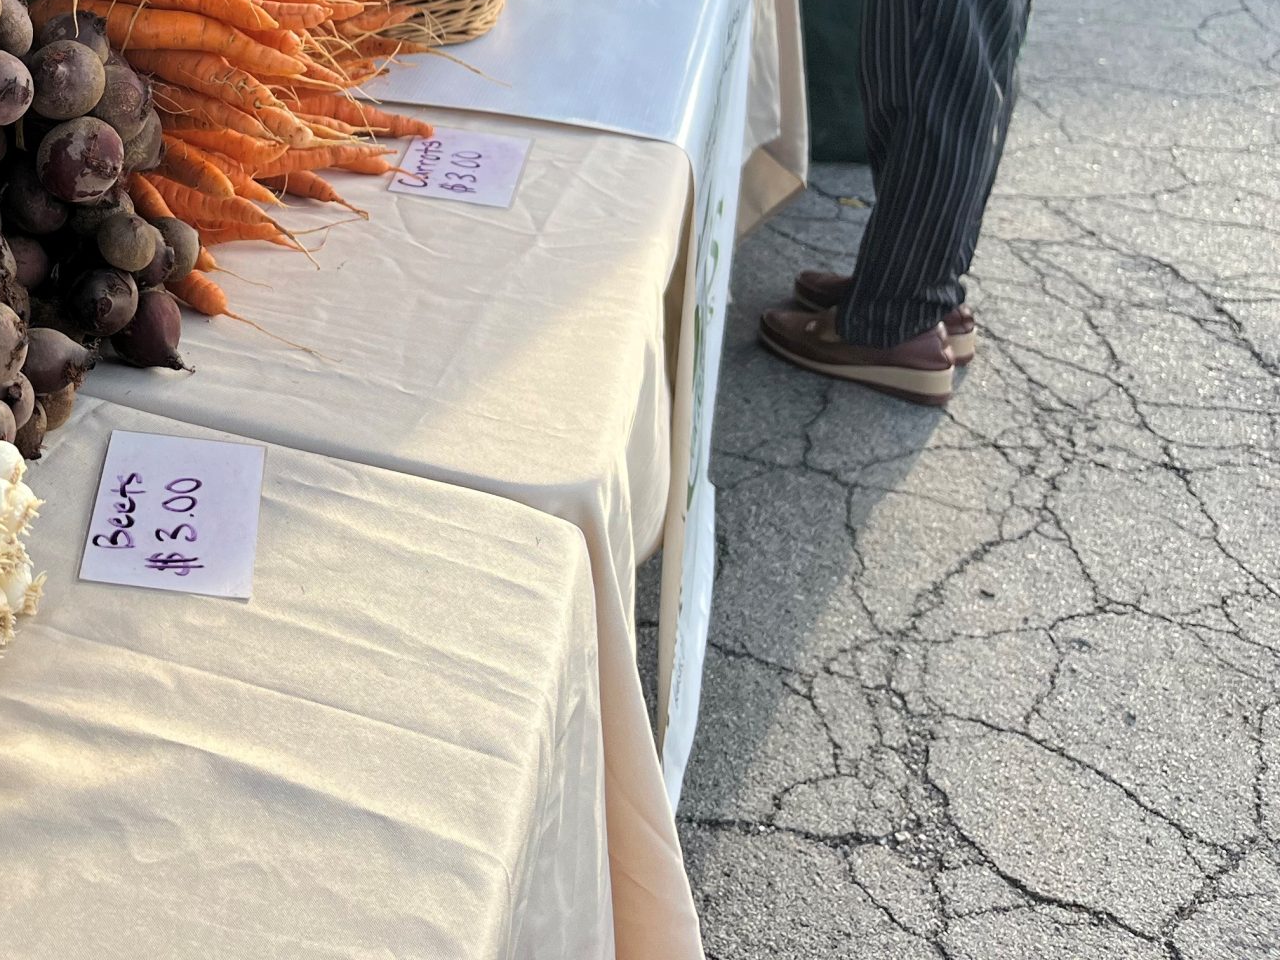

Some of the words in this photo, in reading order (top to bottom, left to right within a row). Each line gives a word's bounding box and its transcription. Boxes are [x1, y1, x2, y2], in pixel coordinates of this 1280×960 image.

[397, 140, 444, 188] Carrots
[438, 150, 483, 194] $3.00
[92, 472, 147, 549] Beets
[144, 477, 205, 577] $3.00
